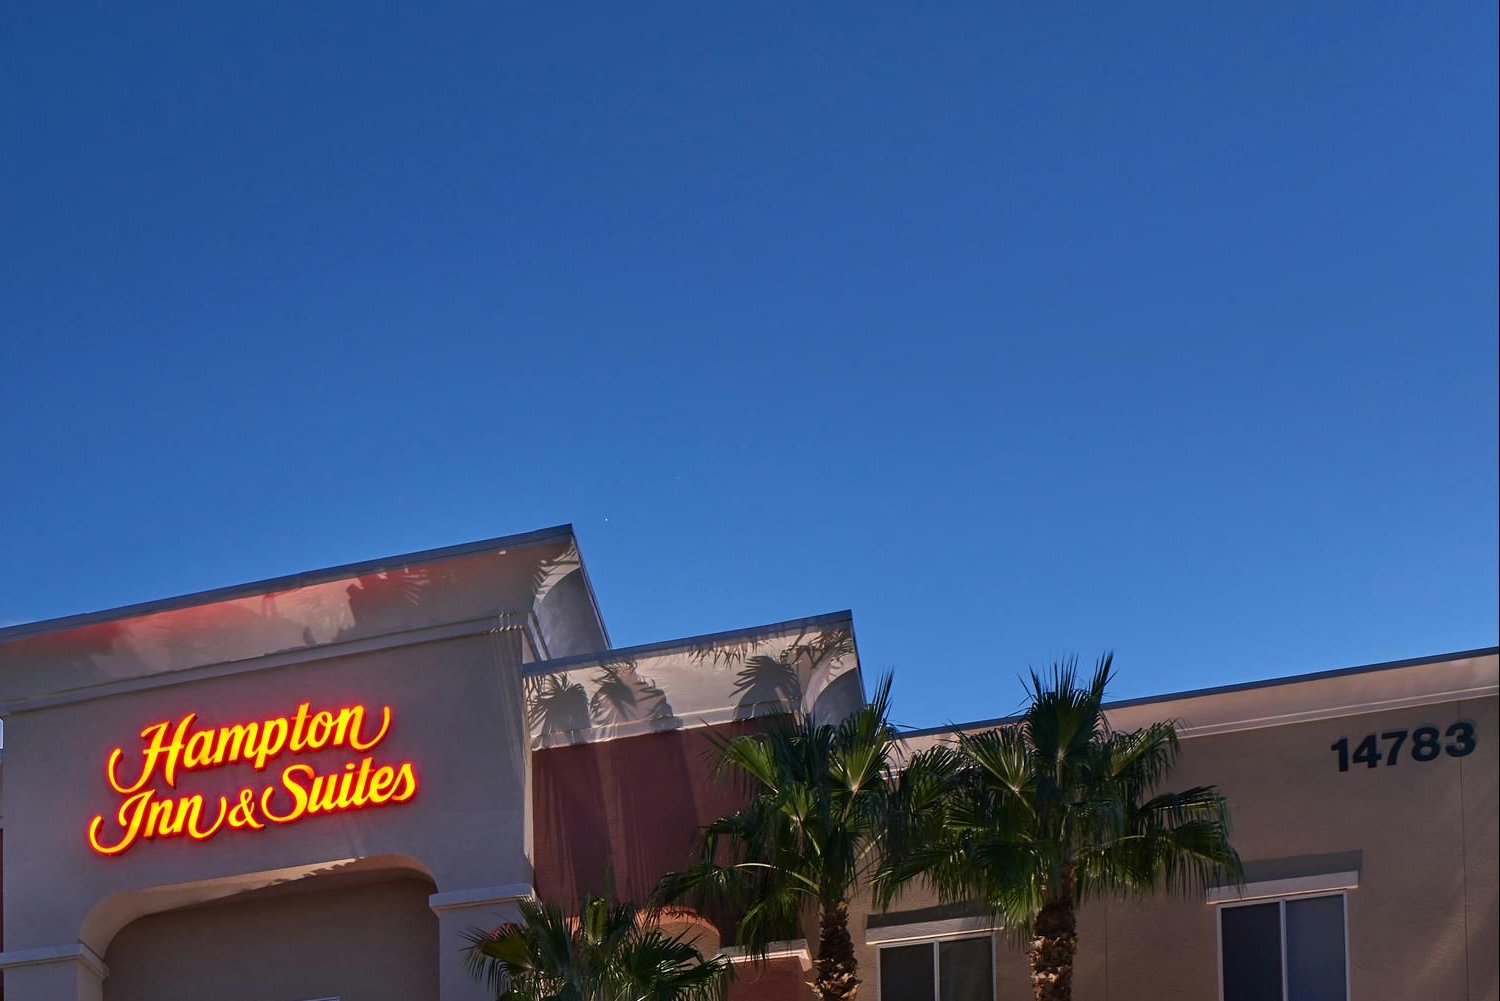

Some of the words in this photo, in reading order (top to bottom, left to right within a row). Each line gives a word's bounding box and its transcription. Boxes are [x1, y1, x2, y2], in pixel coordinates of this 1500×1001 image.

[107, 701, 392, 795] Hampton
[1330, 722, 1477, 773] 14783
[88, 788, 227, 856] Inn
[227, 788, 266, 829] &
[260, 756, 417, 823] Suites
